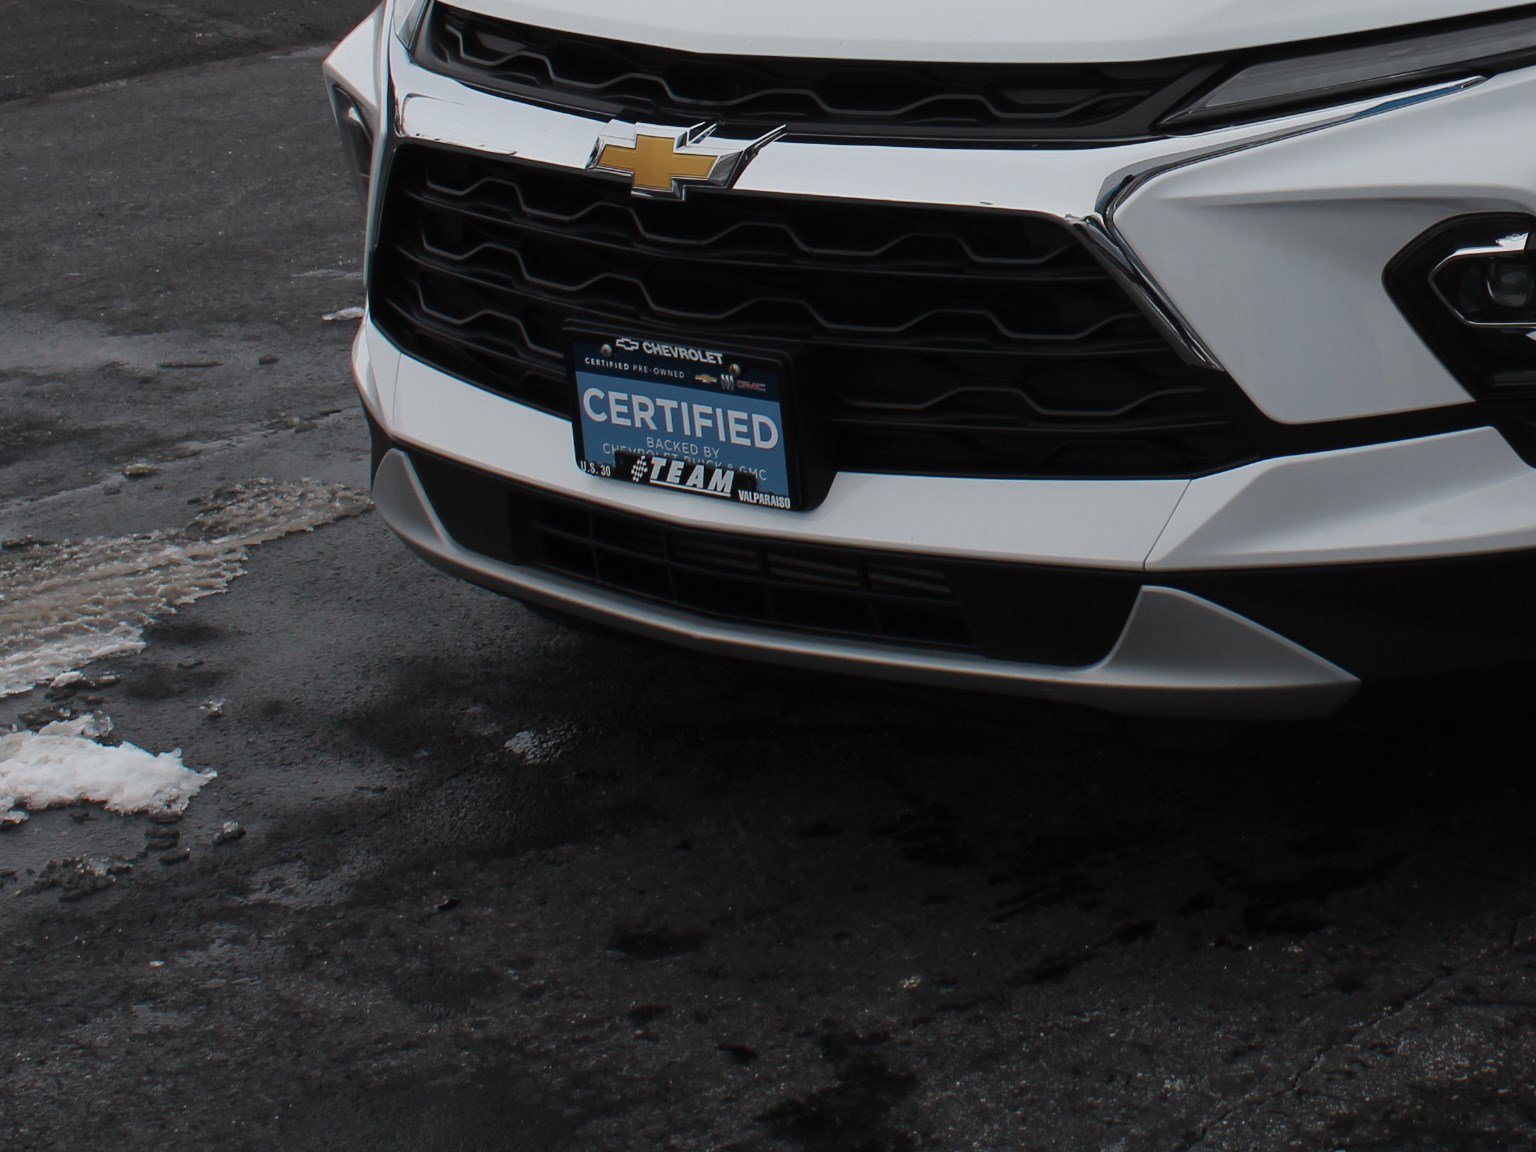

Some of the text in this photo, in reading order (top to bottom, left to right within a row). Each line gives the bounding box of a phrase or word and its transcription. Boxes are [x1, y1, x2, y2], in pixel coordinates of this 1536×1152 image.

[585, 357, 630, 370] CERTIFIED
[642, 341, 724, 365] CHEVROLET
[583, 387, 779, 450] CERTIFIED
[646, 436, 699, 455] BACKED
[703, 446, 720, 459] BY
[600, 462, 611, 477] 30
[650, 457, 735, 495] TEAM
[738, 489, 791, 509] VALPARAISO
